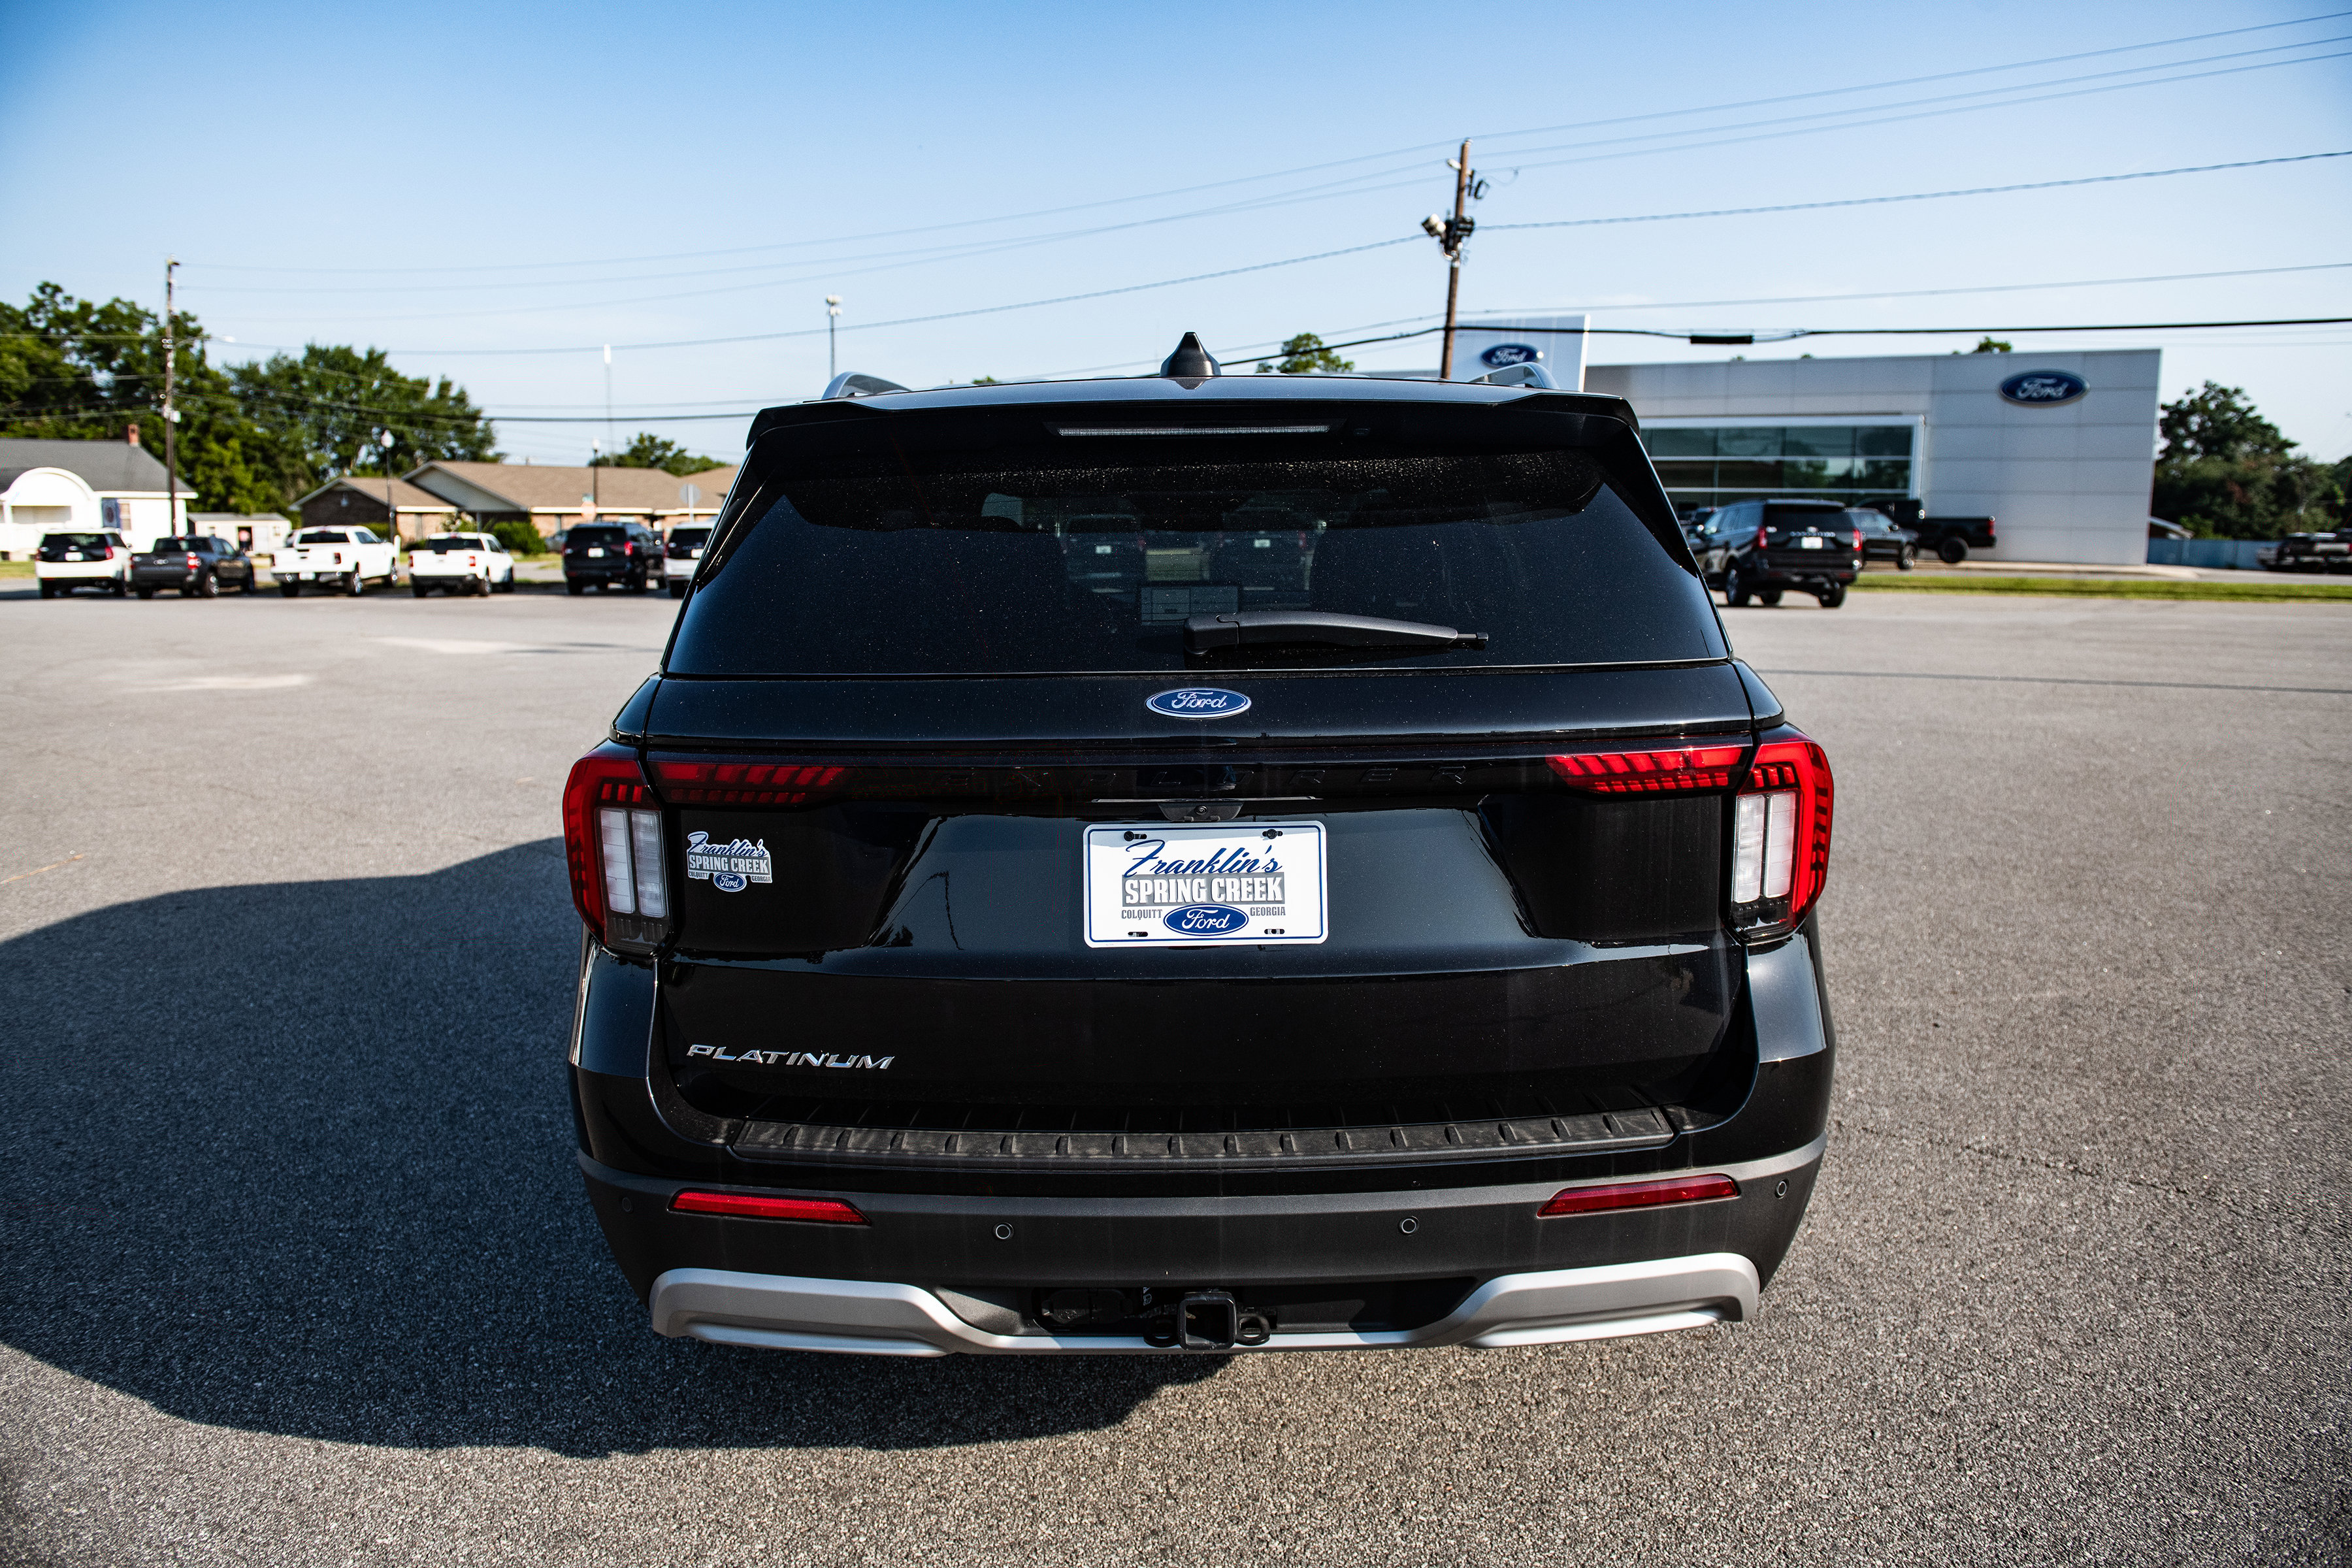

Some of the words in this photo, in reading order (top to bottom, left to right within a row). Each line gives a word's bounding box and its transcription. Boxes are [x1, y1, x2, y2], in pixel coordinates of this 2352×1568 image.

[1491, 348, 1528, 364] Ford
[2016, 378, 2070, 399] Ford
[1171, 691, 1228, 709] Ford
[687, 833, 768, 857] Franklin's
[689, 855, 728, 872] SPRING
[730, 858, 769, 874] CREEK
[1124, 839, 1282, 878] Franklin's
[719, 874, 740, 888] Ford
[1124, 879, 1209, 904] SPRING
[1211, 875, 1283, 902] CREEK
[1121, 909, 1163, 920] COLQUITT
[1250, 906, 1286, 916] GEORGIA
[1181, 909, 1232, 929] Ford
[686, 1044, 895, 1070] PLATINUM
